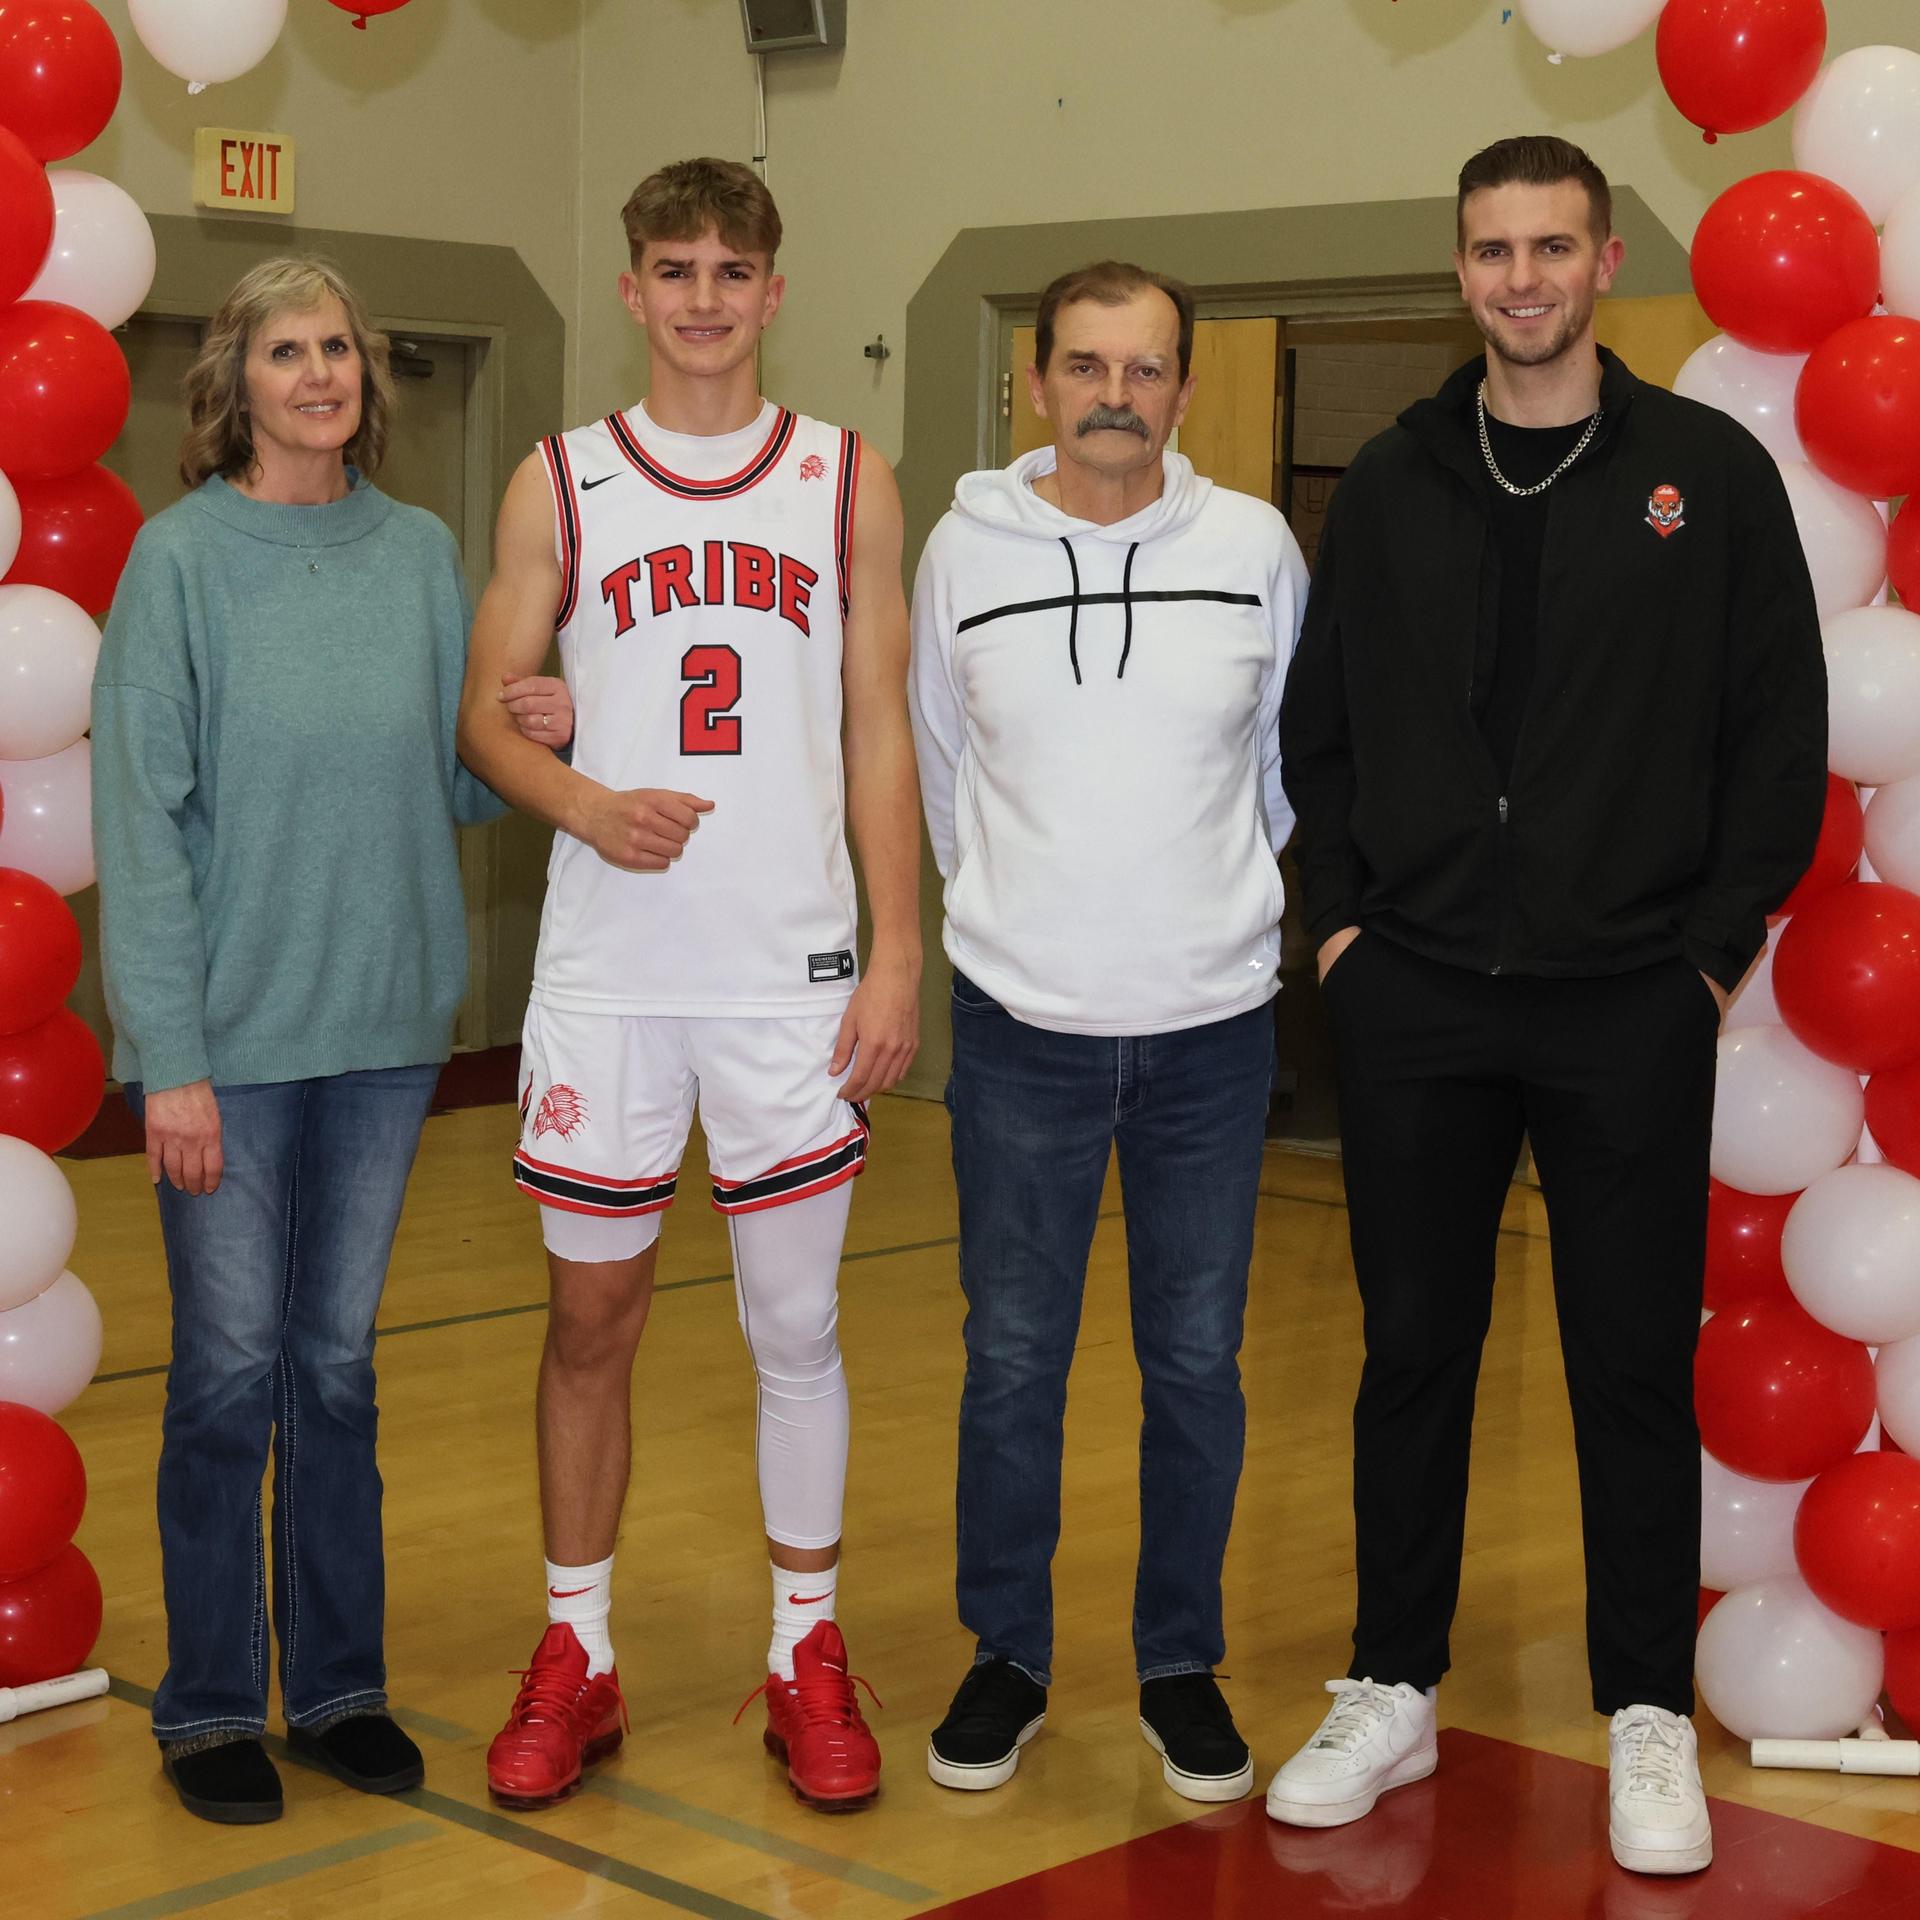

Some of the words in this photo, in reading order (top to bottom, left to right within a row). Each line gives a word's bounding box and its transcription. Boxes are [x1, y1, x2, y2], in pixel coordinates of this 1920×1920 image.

[221, 139, 282, 201] EXIT
[600, 540, 819, 639] TRIBE
[680, 644, 742, 756] 2
